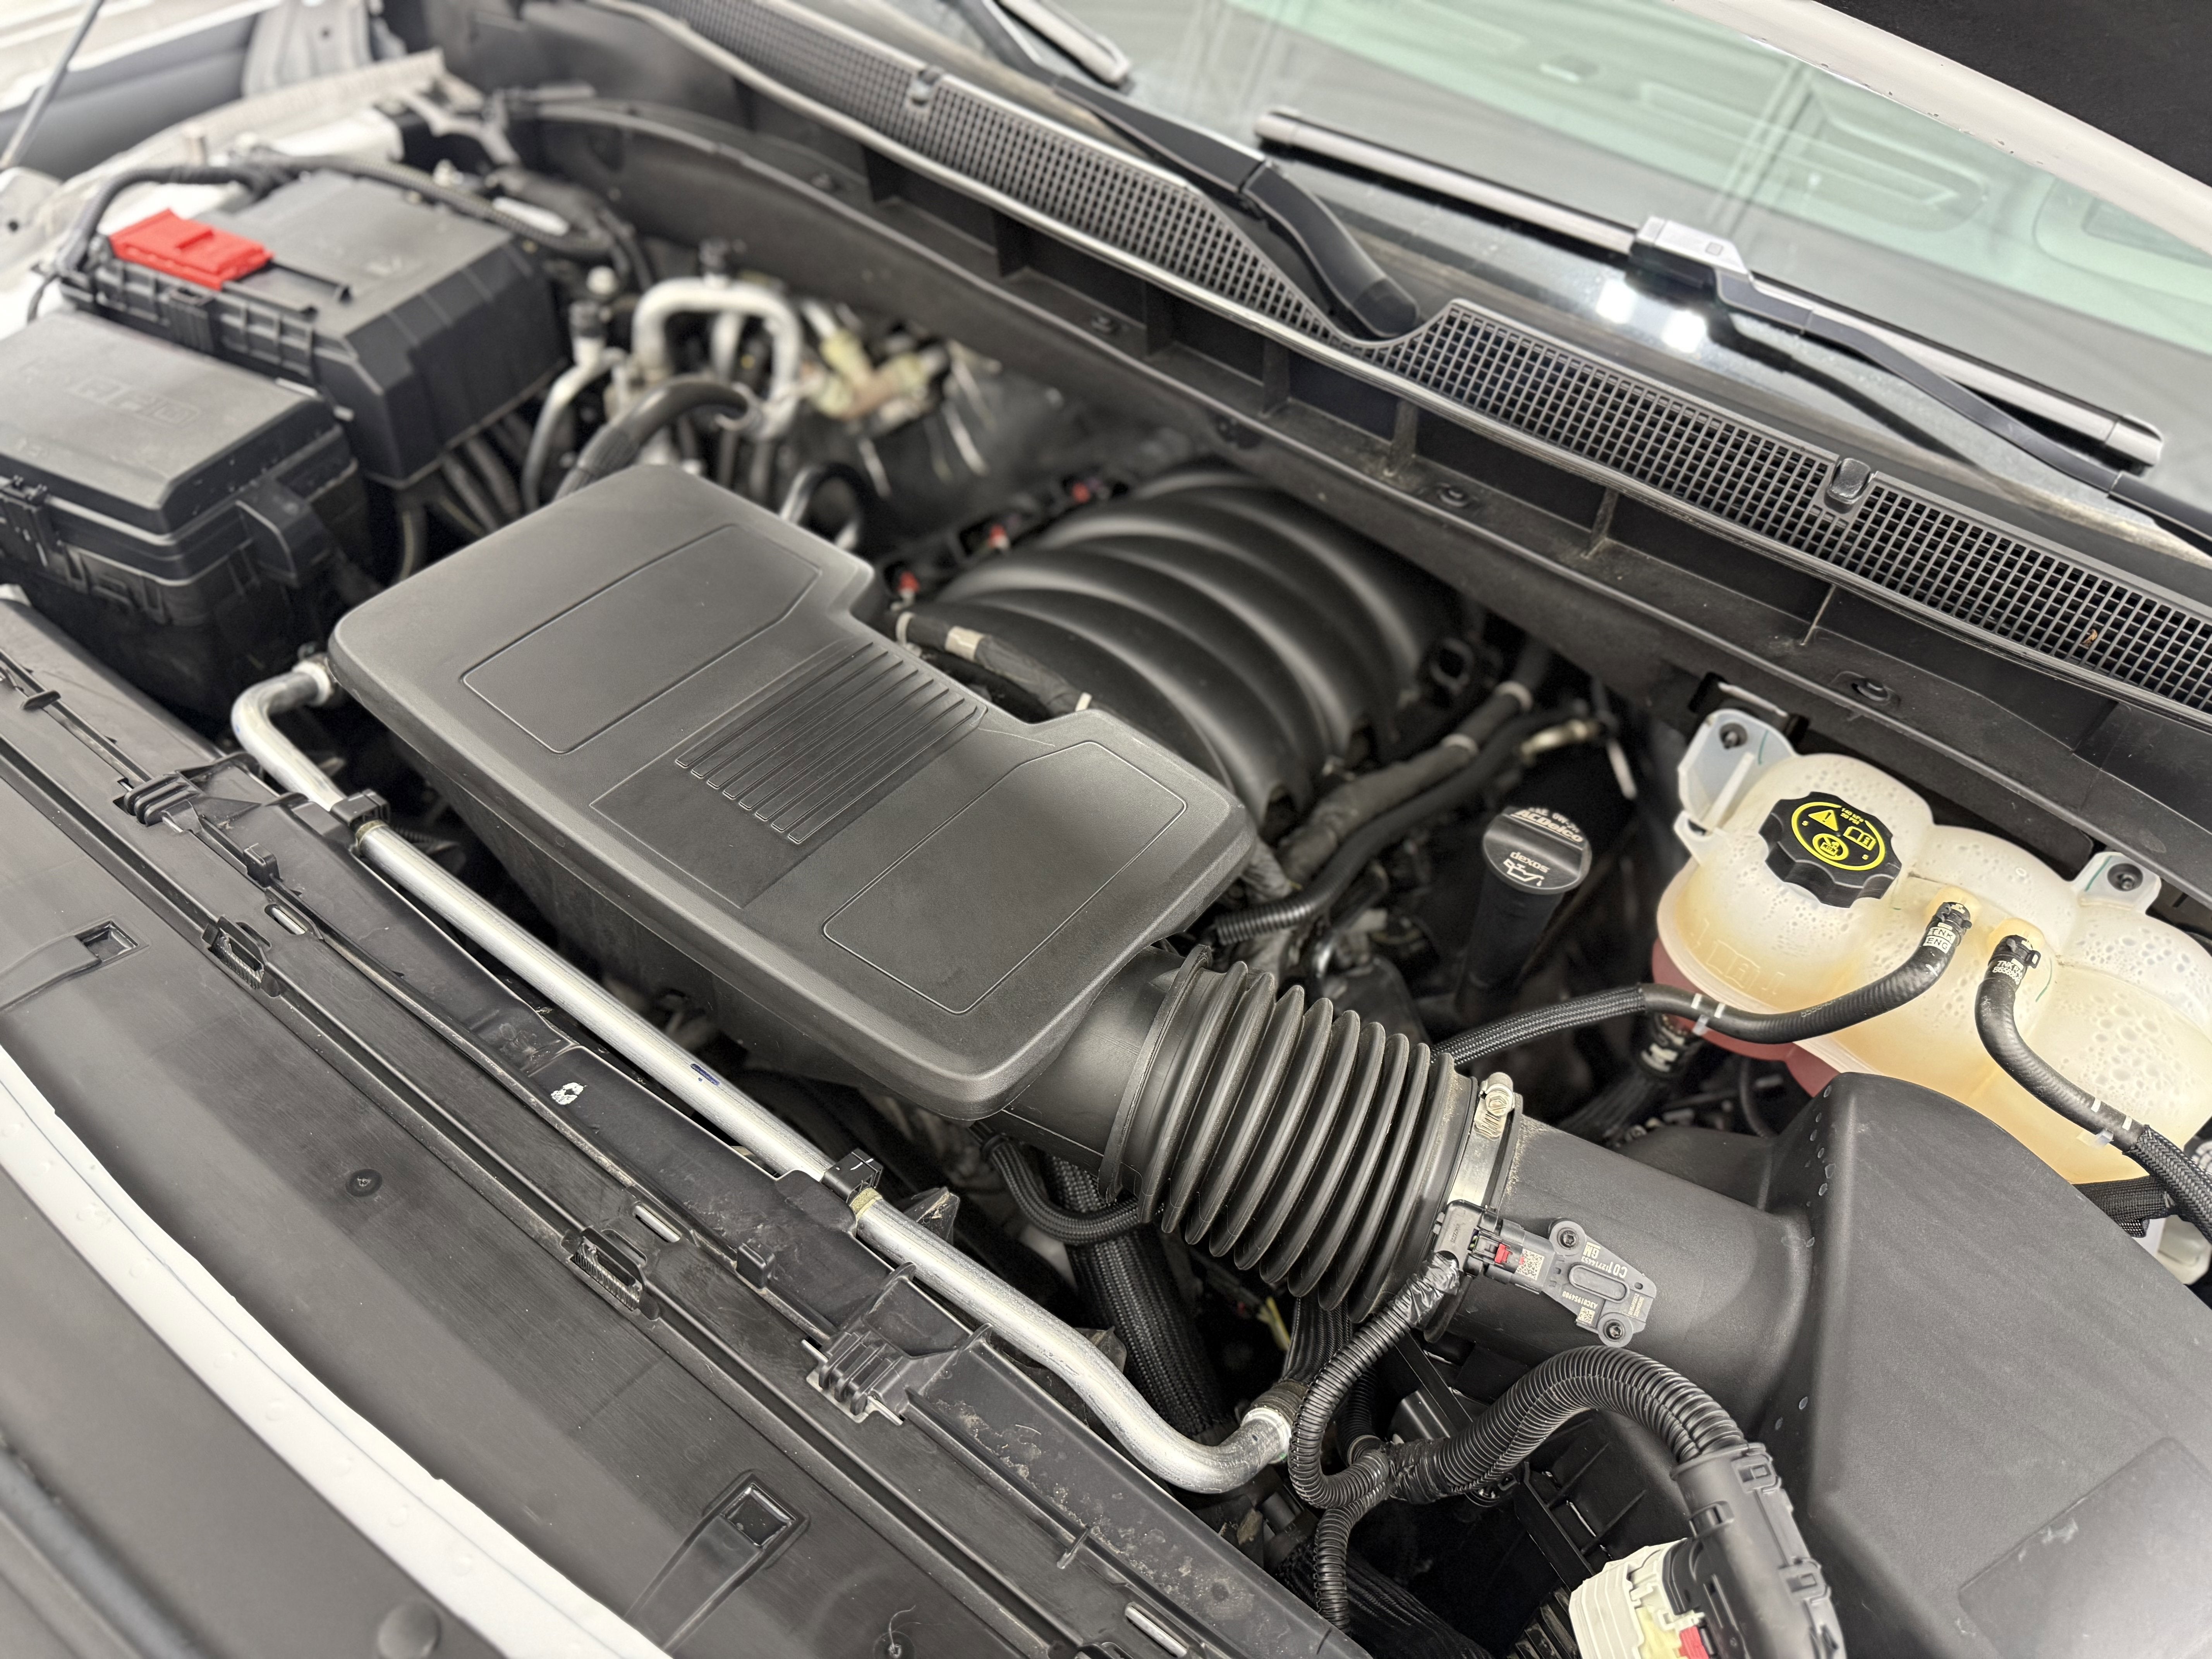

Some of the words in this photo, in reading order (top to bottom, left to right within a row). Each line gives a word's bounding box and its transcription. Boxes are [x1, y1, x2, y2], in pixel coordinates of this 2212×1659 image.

[1515, 810, 1583, 842] ACDelco
[1510, 852, 1550, 873] dexos
[1932, 929, 1953, 940] TNK
[1927, 938, 1948, 950] ENG
[1997, 961, 2014, 969] TNK
[1583, 1244, 1600, 1259] GM
[1607, 1262, 1628, 1278] C01
